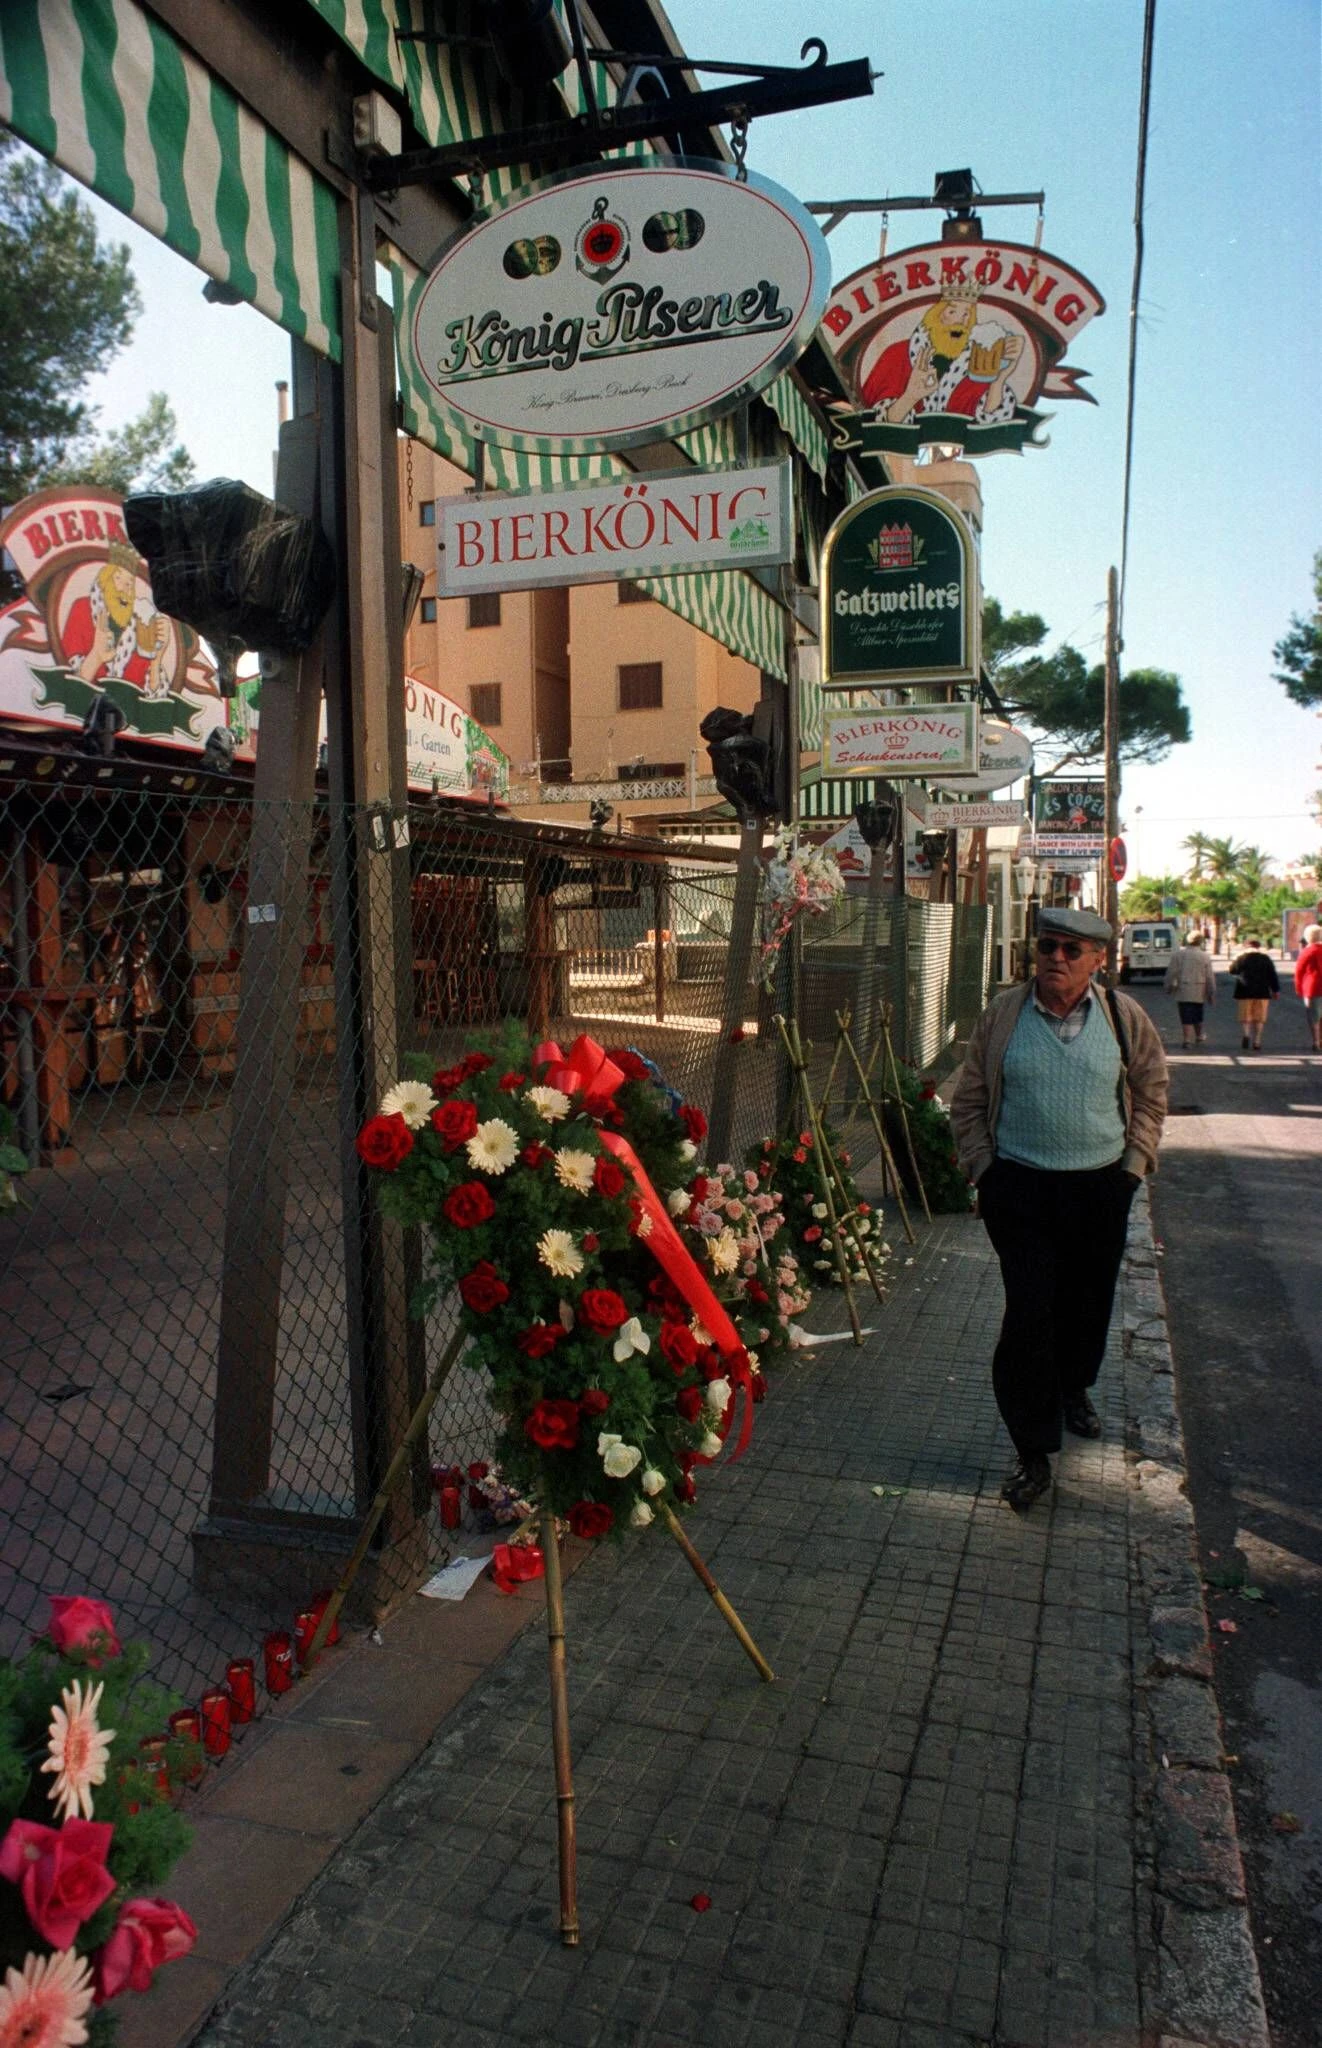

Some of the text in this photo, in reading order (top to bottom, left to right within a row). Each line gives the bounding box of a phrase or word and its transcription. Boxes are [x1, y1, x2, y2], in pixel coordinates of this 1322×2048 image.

[821, 249, 1086, 337] BIERKÖNIG
[23, 510, 128, 560] BIERK
[835, 583, 960, 617] Gatzweilers
[834, 716, 963, 745] BIERKÖNIG
[835, 751, 944, 763] Schinkenstra
